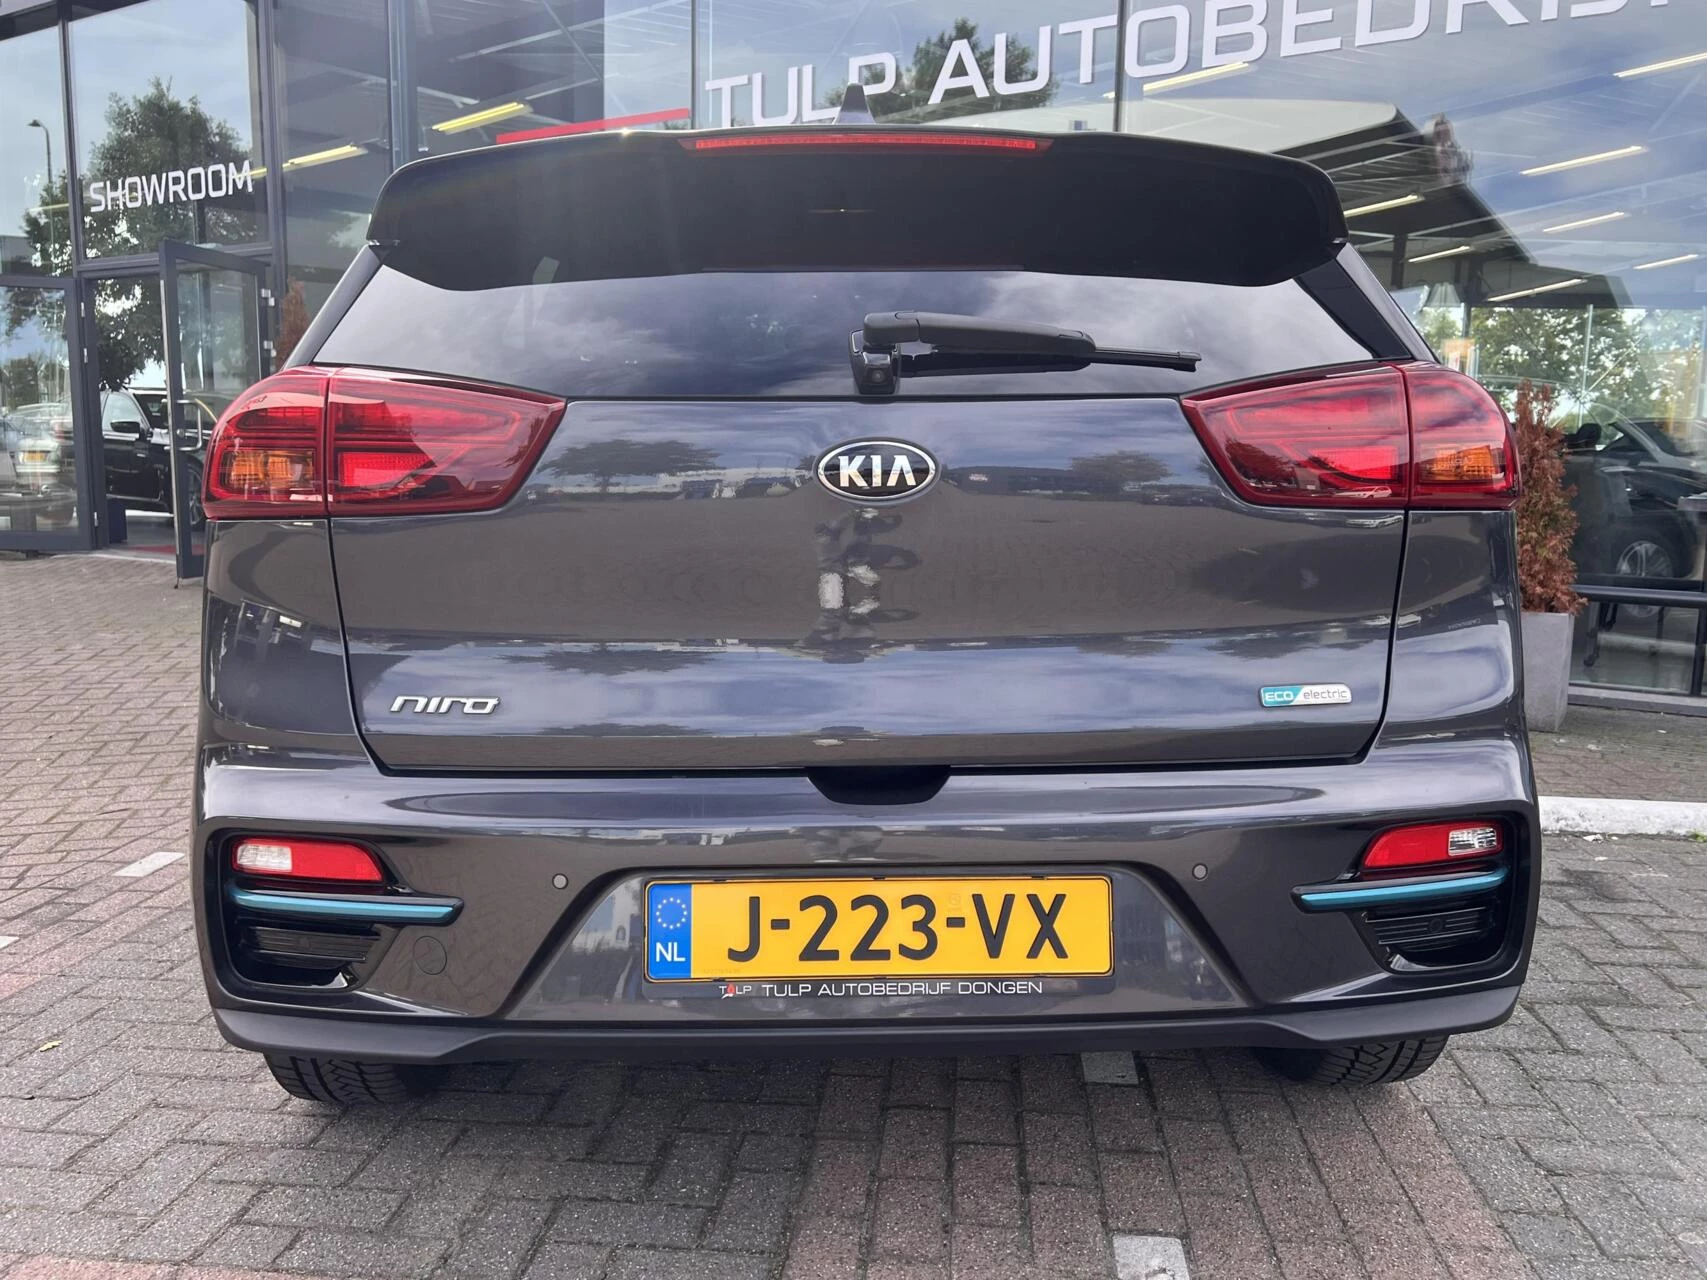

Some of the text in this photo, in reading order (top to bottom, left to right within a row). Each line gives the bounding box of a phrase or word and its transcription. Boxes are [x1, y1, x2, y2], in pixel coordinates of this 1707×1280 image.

[705, 52, 897, 126] TULP
[89, 159, 253, 213] SHOWROOM
[838, 454, 917, 488] KIA
[1264, 689, 1348, 702] ECO electric
[727, 893, 1069, 963] J-223-VX
[655, 942, 686, 962] NL
[761, 981, 1043, 997] TULP AUTOBEDRIJF DONGEN
